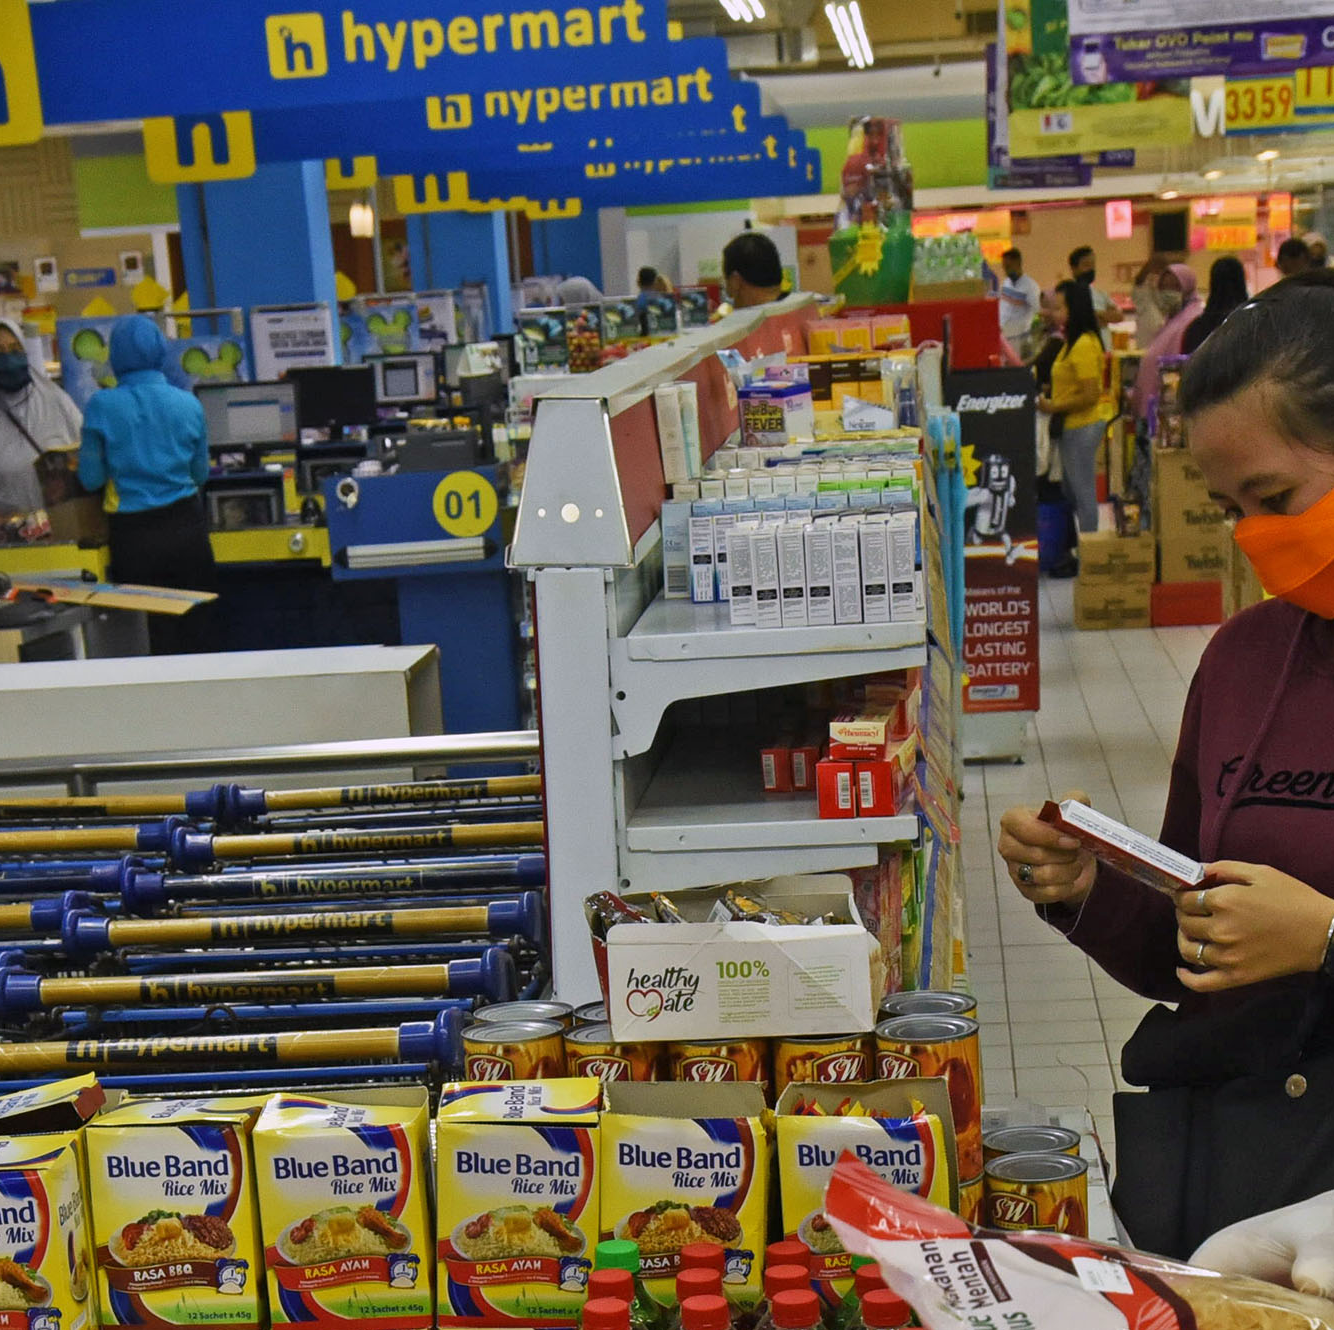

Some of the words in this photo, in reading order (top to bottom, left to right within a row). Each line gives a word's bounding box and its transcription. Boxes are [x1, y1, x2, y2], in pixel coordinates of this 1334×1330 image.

[341, 0, 646, 72] hypermart
[1156, 32, 1189, 48] OVO
[1193, 31, 1230, 46] Point
[1225, 86, 1293, 122] 3359
[956, 393, 1027, 414] Energizer
[745, 417, 785, 433] FEVER
[443, 490, 482, 521] 01
[966, 600, 1031, 617] WORLD'S
[965, 621, 1030, 638] LONGEST
[965, 641, 1026, 658] LASTING
[967, 662, 1031, 678] BATTERY
[715, 960, 771, 980] 100%
[626, 967, 701, 997] healthy
[456, 1151, 512, 1176] Blue
[515, 1153, 581, 1179] Band
[619, 1142, 673, 1168] Blue
[676, 1145, 742, 1170] Band
[797, 1143, 837, 1168] Blu
[856, 1143, 923, 1168] Band
[107, 1154, 162, 1179] Blue
[165, 1153, 230, 1178] Band
[273, 1155, 329, 1181] Blue
[332, 1151, 399, 1177] Band
[161, 1178, 196, 1197] Rice
[199, 1179, 229, 1197] Mix
[330, 1178, 365, 1196] Rice
[369, 1176, 398, 1194] Mix
[510, 1177, 545, 1196] Rice
[549, 1178, 578, 1197] Mix
[671, 1171, 706, 1189] Rice
[710, 1170, 739, 1189] Mix
[892, 1169, 921, 1186] Mix
[4, 1226, 36, 1244] Mix
[133, 1267, 166, 1282] RASA
[169, 1262, 194, 1278] BBQ
[303, 1264, 337, 1280] RASA
[339, 1259, 371, 1275] AYAM
[475, 1261, 508, 1275] RASA
[510, 1259, 542, 1274] AYAM
[949, 1250, 995, 1311] Mentah
[199, 1310, 226, 1322] Sachet
[235, 1310, 253, 1323] 45g
